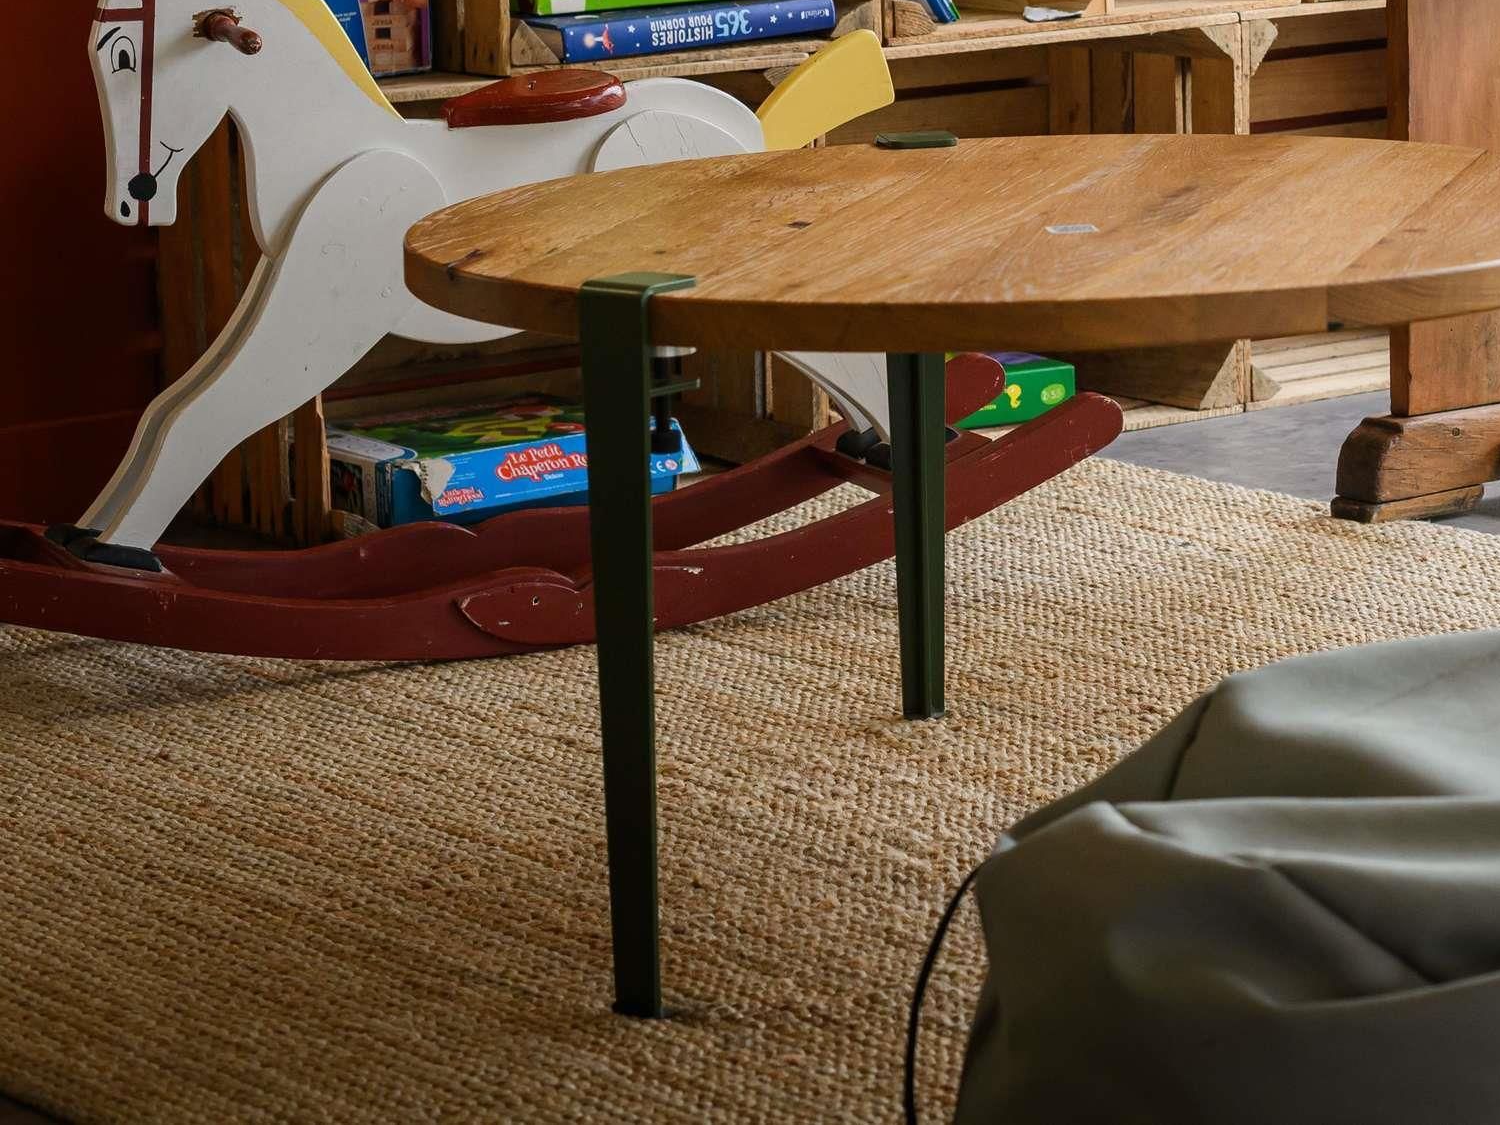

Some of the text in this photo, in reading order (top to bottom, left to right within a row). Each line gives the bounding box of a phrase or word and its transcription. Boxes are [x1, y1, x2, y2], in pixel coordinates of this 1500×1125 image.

[650, 14, 713, 33] POUR DORMIR
[715, 9, 753, 38] 365
[652, 25, 714, 47] HISTOIRES
[511, 445, 563, 464] Le Petit
[497, 457, 569, 481] Chaperon
